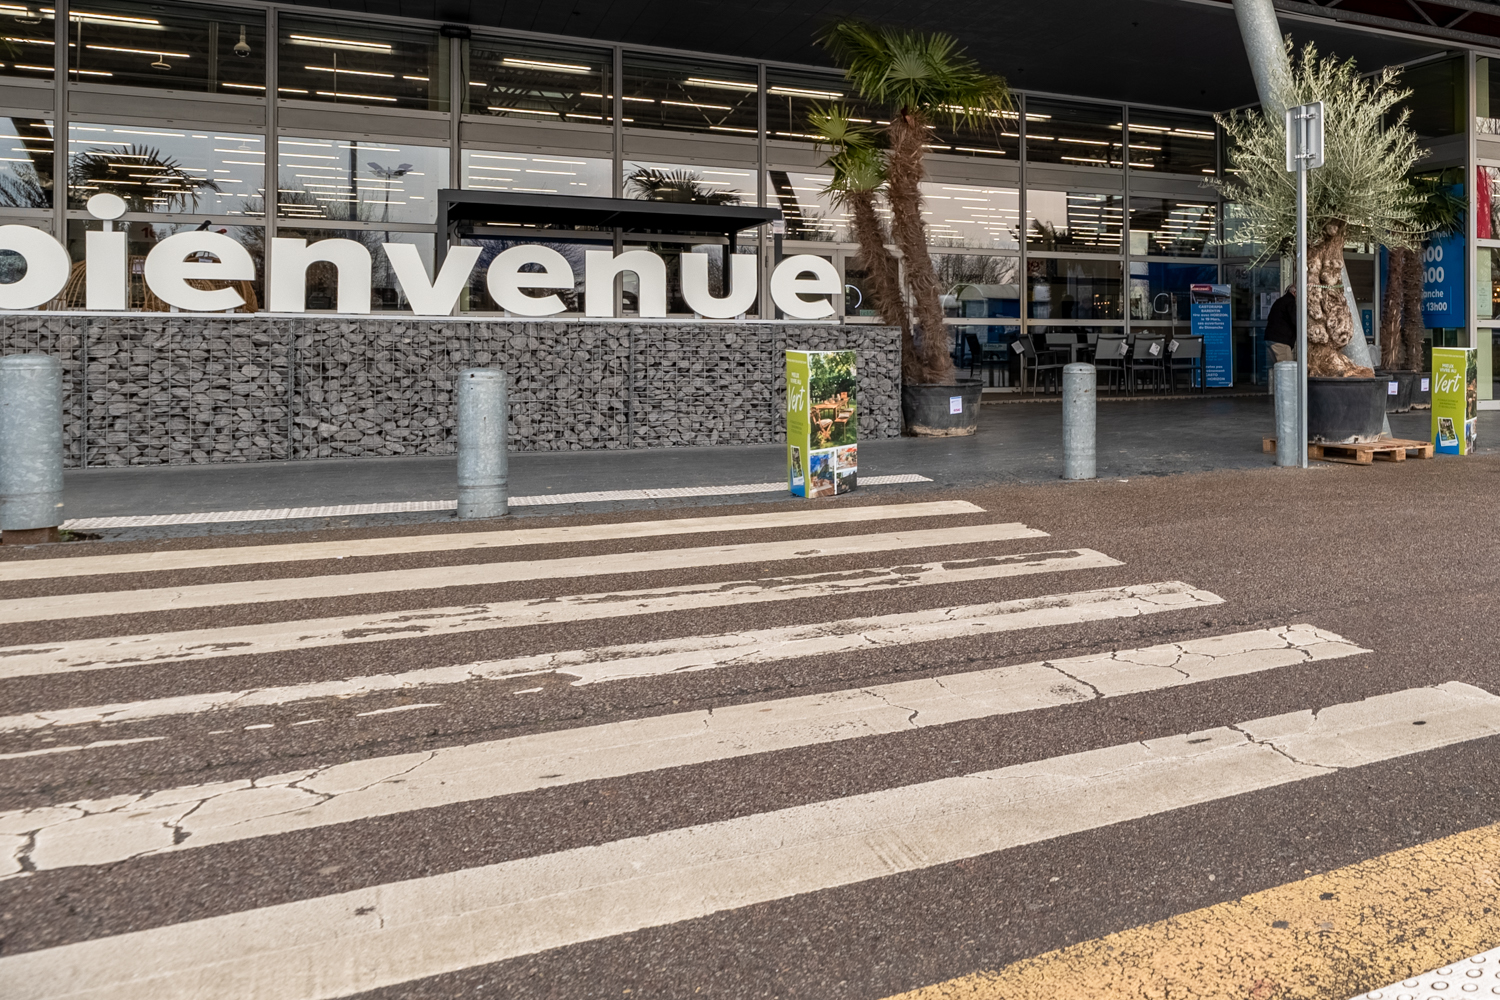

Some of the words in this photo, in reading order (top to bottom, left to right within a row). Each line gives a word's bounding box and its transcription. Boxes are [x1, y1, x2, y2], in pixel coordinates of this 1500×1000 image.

[1421, 288, 1444, 299] anche
[1434, 372, 1462, 394] Vert
[788, 383, 806, 412] Vert
